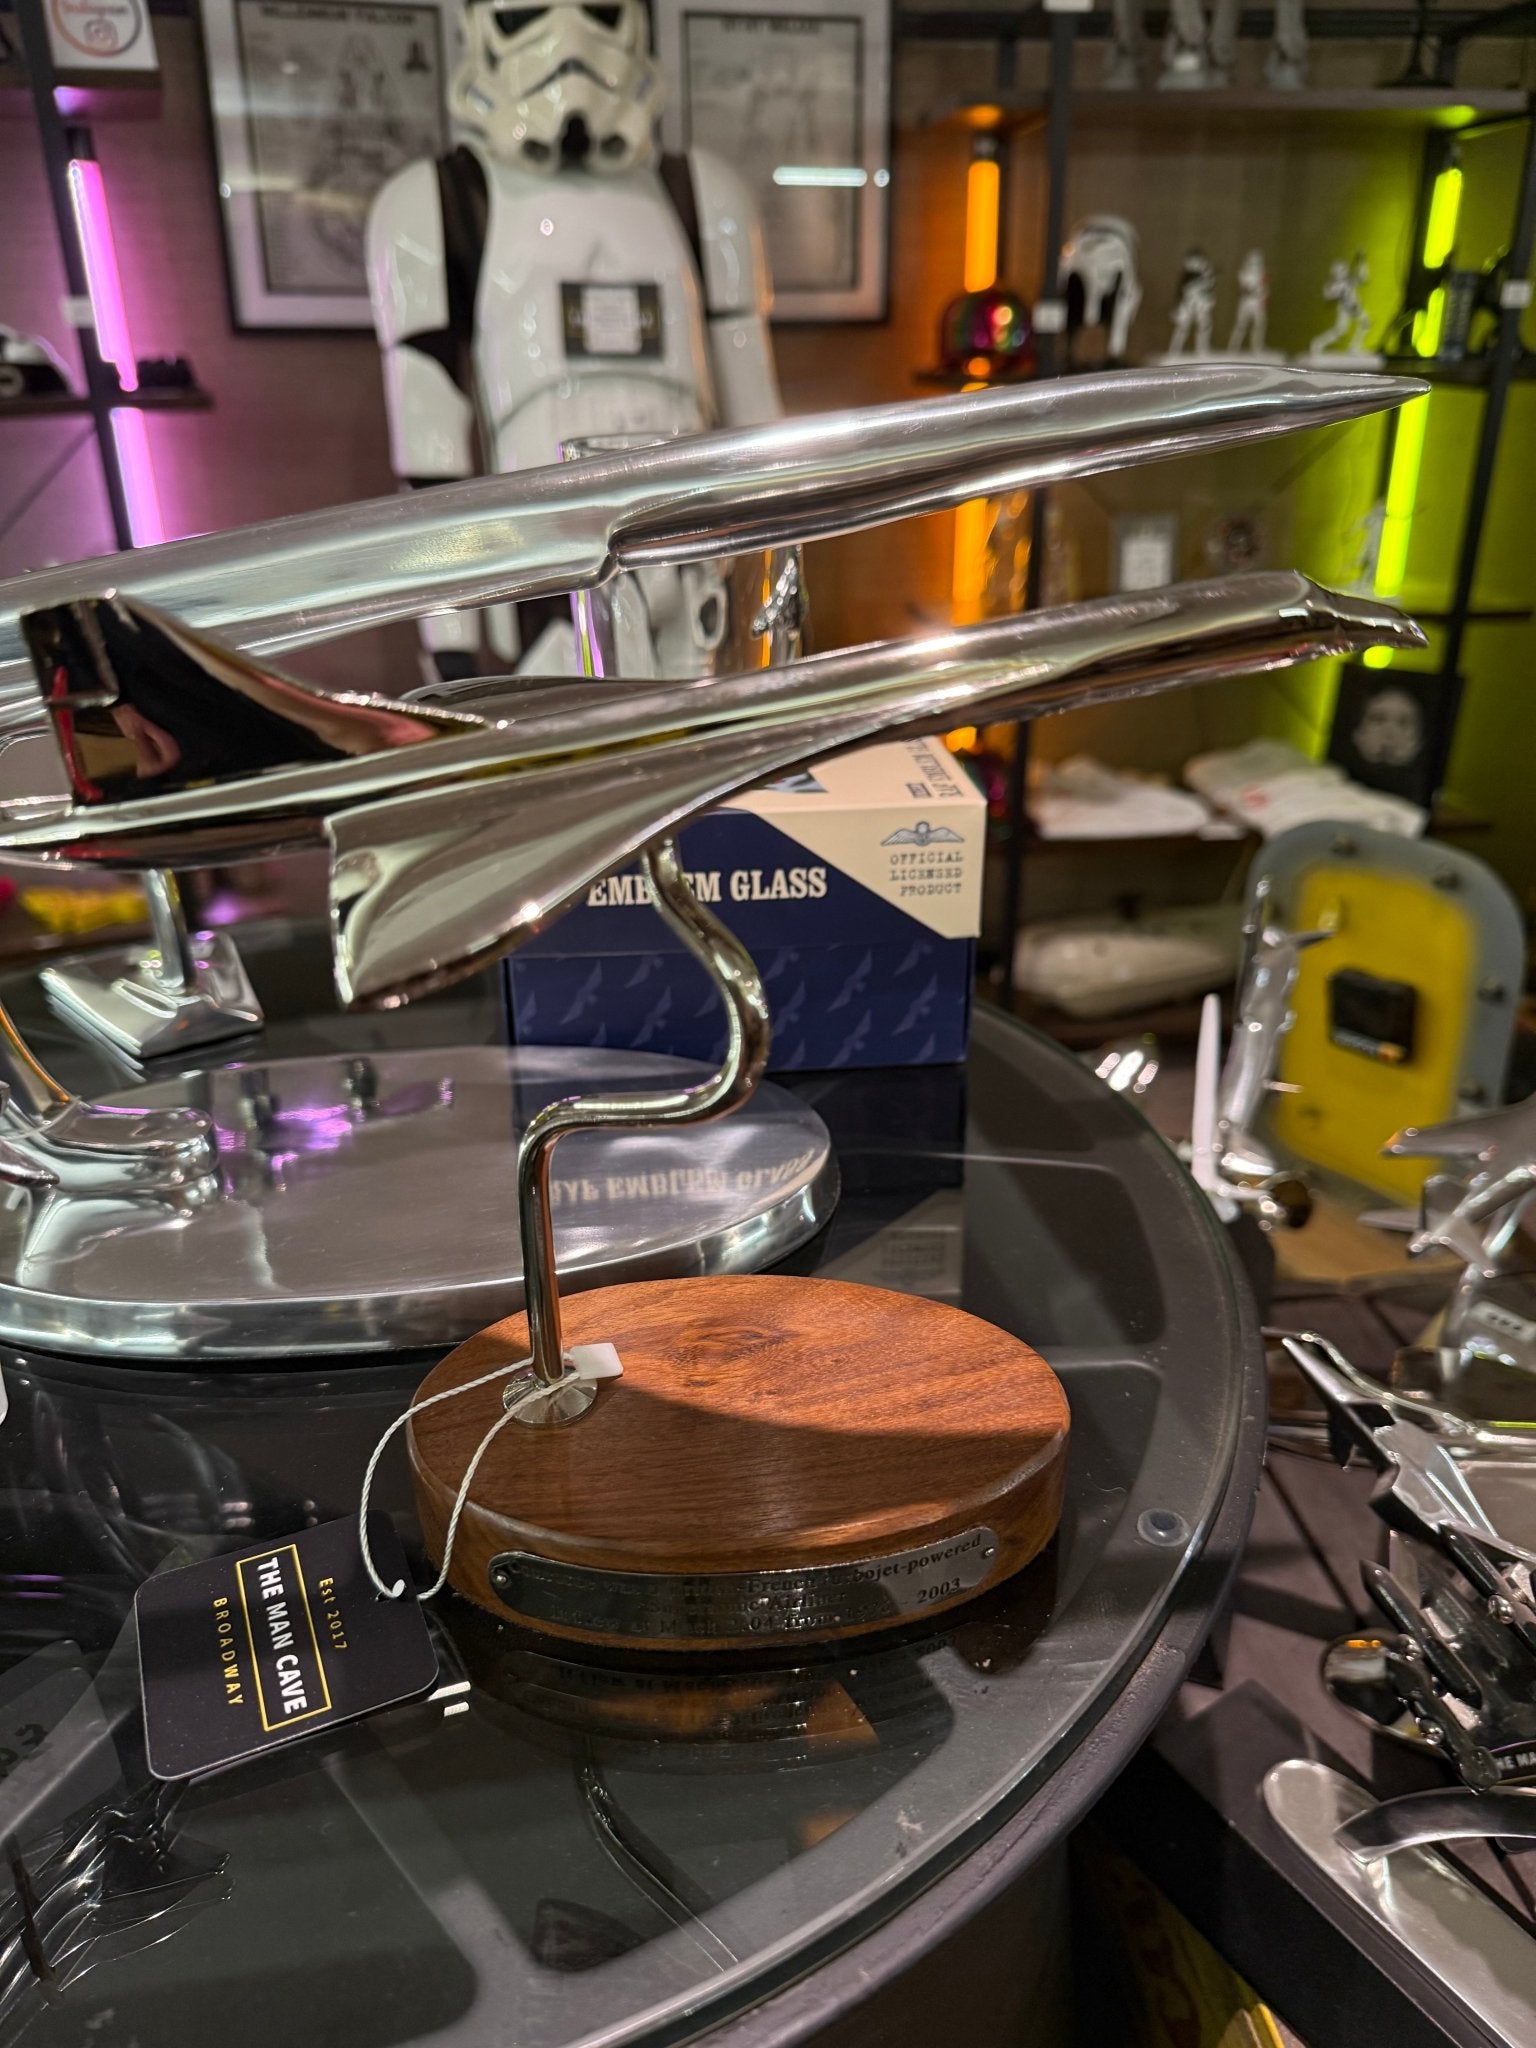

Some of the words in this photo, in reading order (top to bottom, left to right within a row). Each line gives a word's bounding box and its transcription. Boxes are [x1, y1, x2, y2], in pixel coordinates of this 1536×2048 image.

[889, 867, 962, 881] LICENSED
[890, 852, 963, 865] OFFICIAL
[586, 872, 721, 907] EMBEM
[729, 867, 828, 902] GLASS
[900, 883, 962, 896] PRODUCT
[256, 1556, 283, 1599] THE
[318, 1577, 337, 1604] Est
[917, 1577, 961, 1604] 2003
[266, 1601, 294, 1651] MAN
[326, 1610, 348, 1650] 2017
[212, 1597, 244, 1706] BROADWAY
[275, 1653, 308, 1715] CAVE
